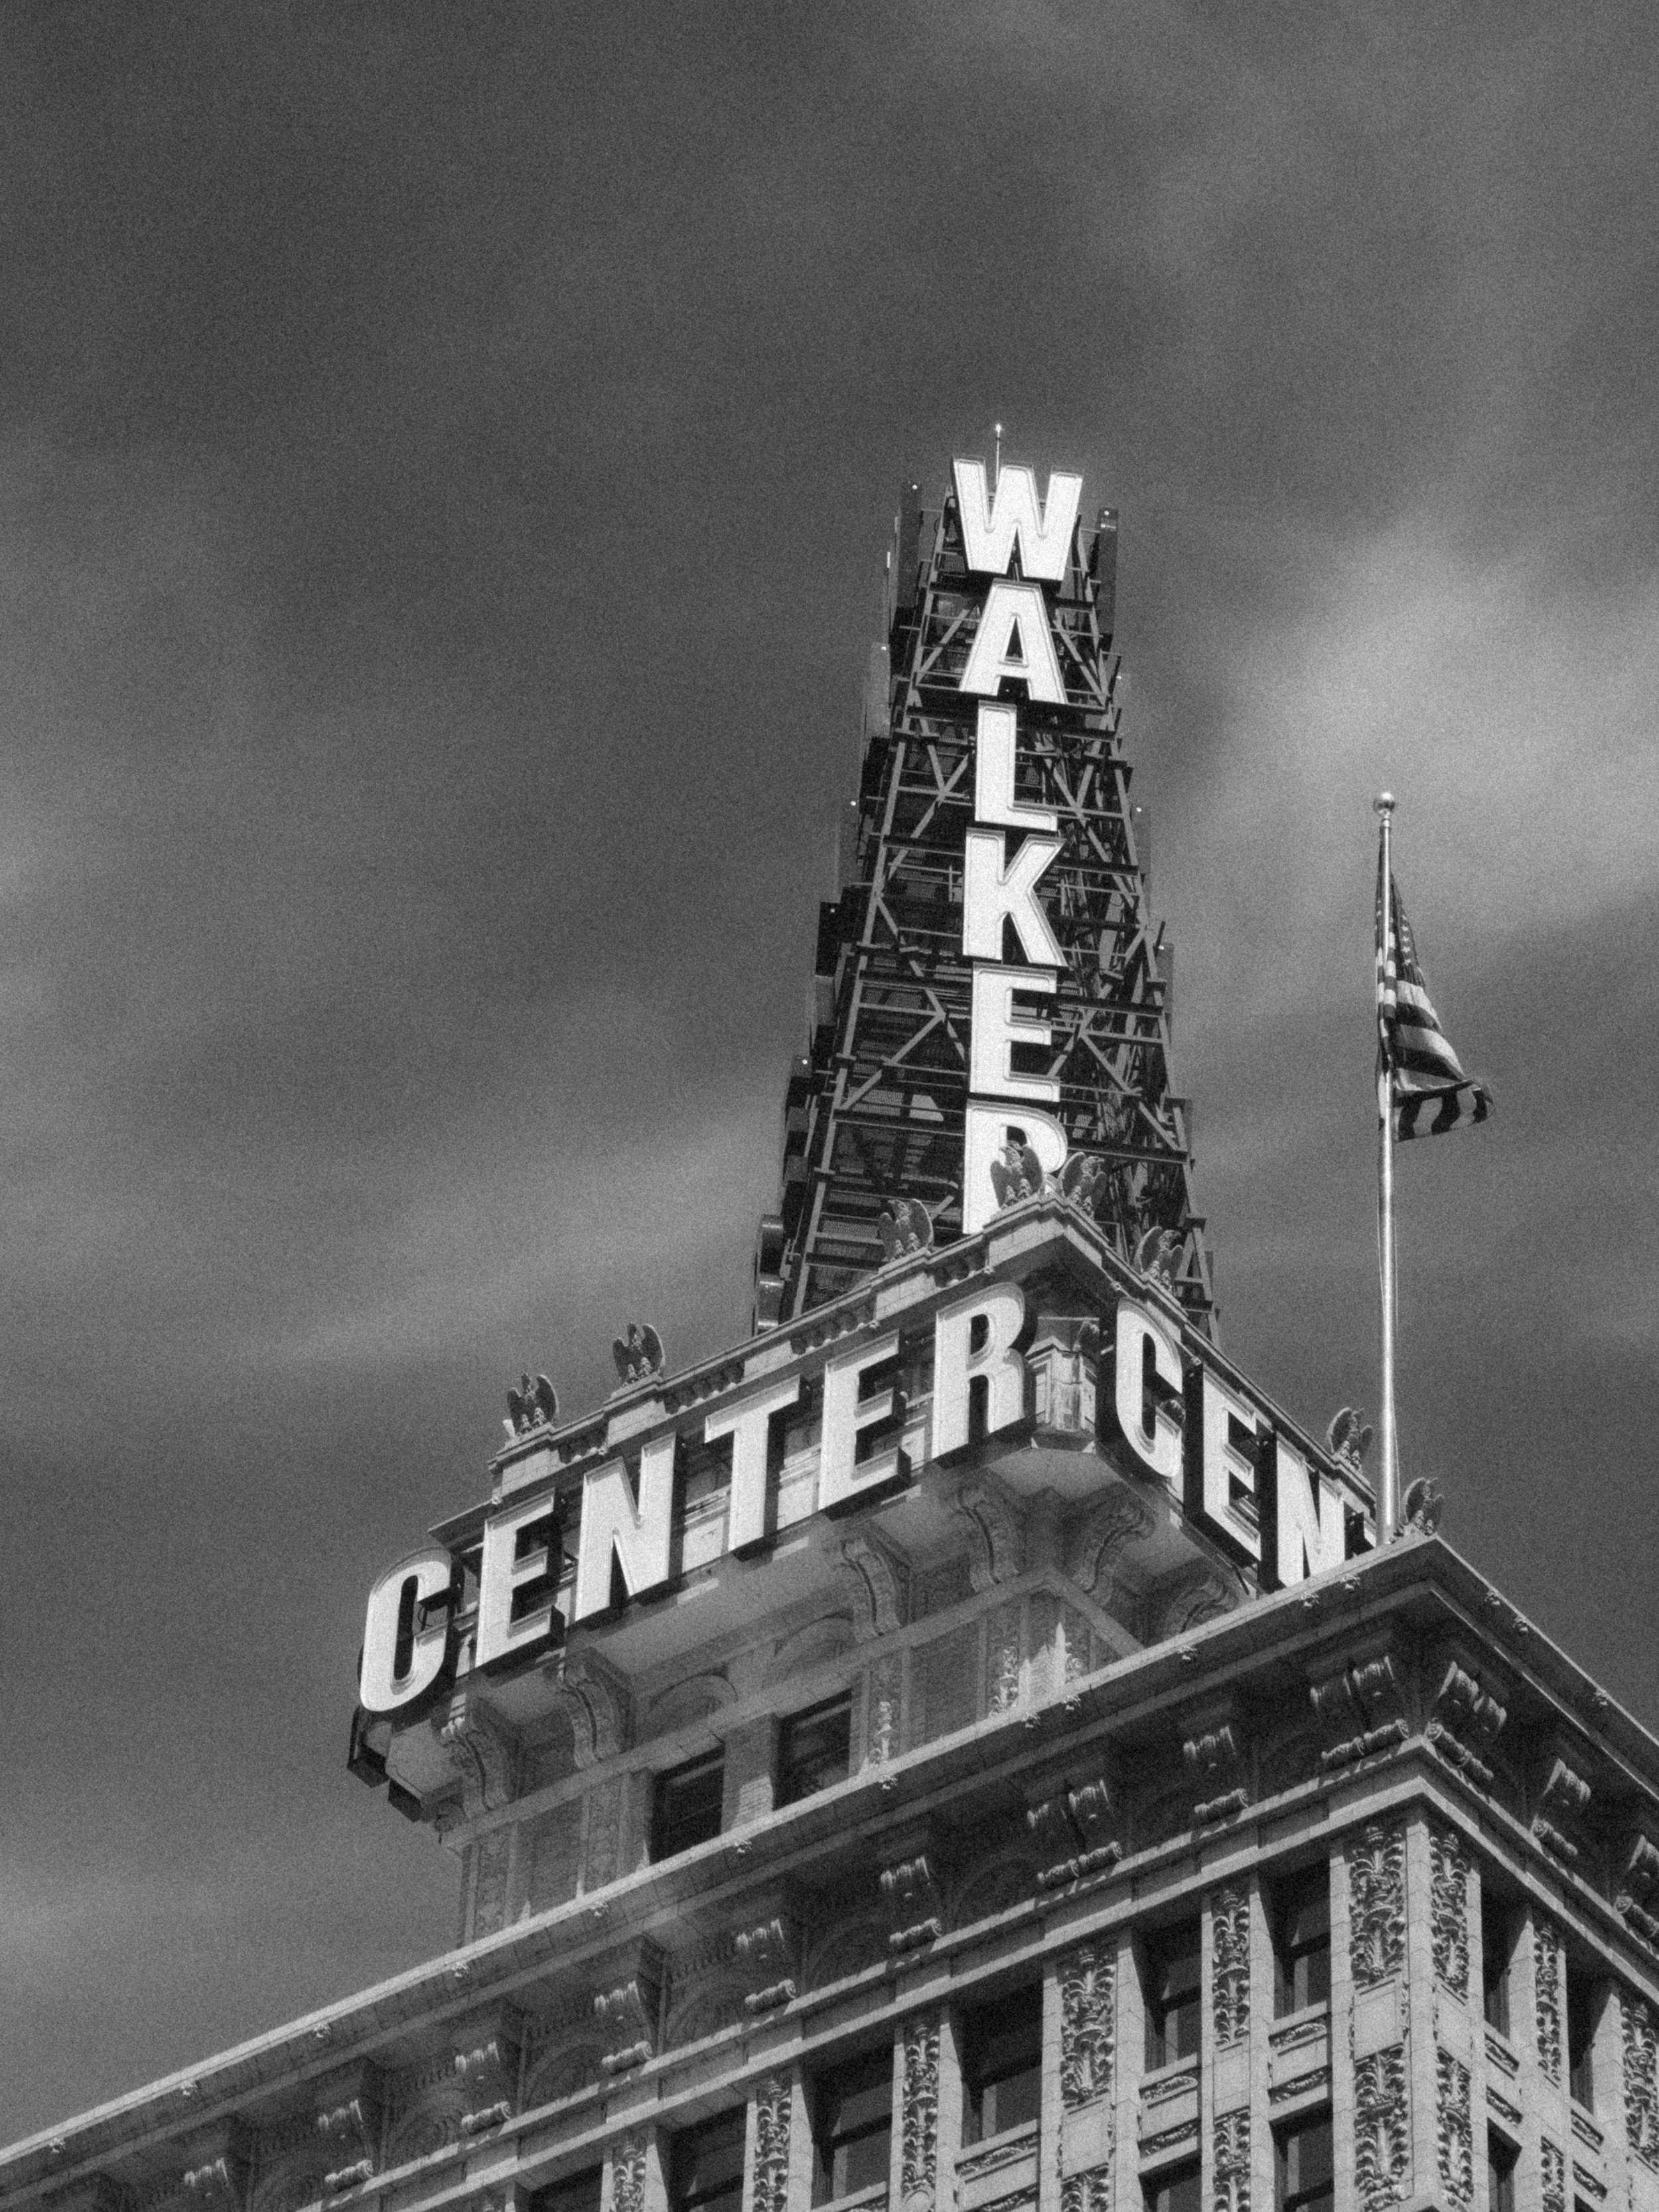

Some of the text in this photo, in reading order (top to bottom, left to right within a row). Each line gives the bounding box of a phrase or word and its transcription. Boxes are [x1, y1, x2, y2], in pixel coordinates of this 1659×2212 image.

[953, 455, 1084, 1234] WALKER
[360, 1282, 1026, 1712] CENTER
[1116, 1298, 1376, 1588] CEN
